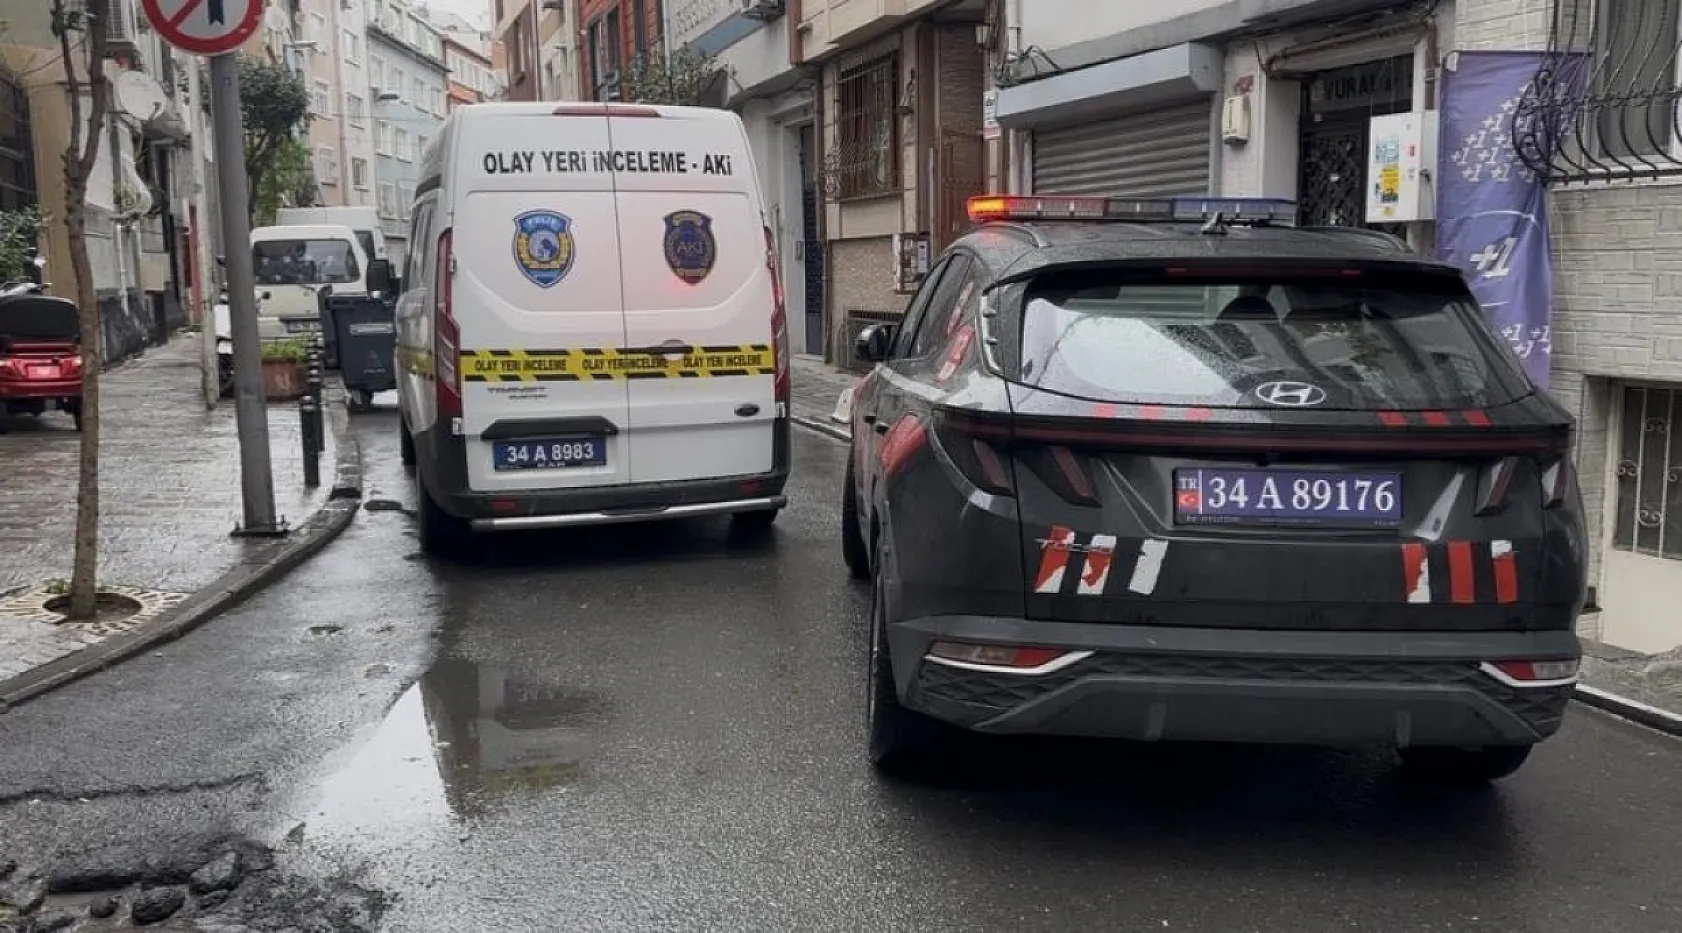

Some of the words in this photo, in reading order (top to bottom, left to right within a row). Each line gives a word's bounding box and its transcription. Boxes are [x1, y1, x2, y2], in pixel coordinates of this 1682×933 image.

[484, 151, 535, 174] OLAY
[1470, 237, 1516, 277] +1
[507, 445, 529, 462] 34
[535, 445, 546, 461] A
[551, 442, 594, 461] 8983
[1179, 478, 1197, 489] TR
[1208, 477, 1248, 509] 34
[1256, 477, 1285, 510] A
[1292, 479, 1394, 511] 89176
